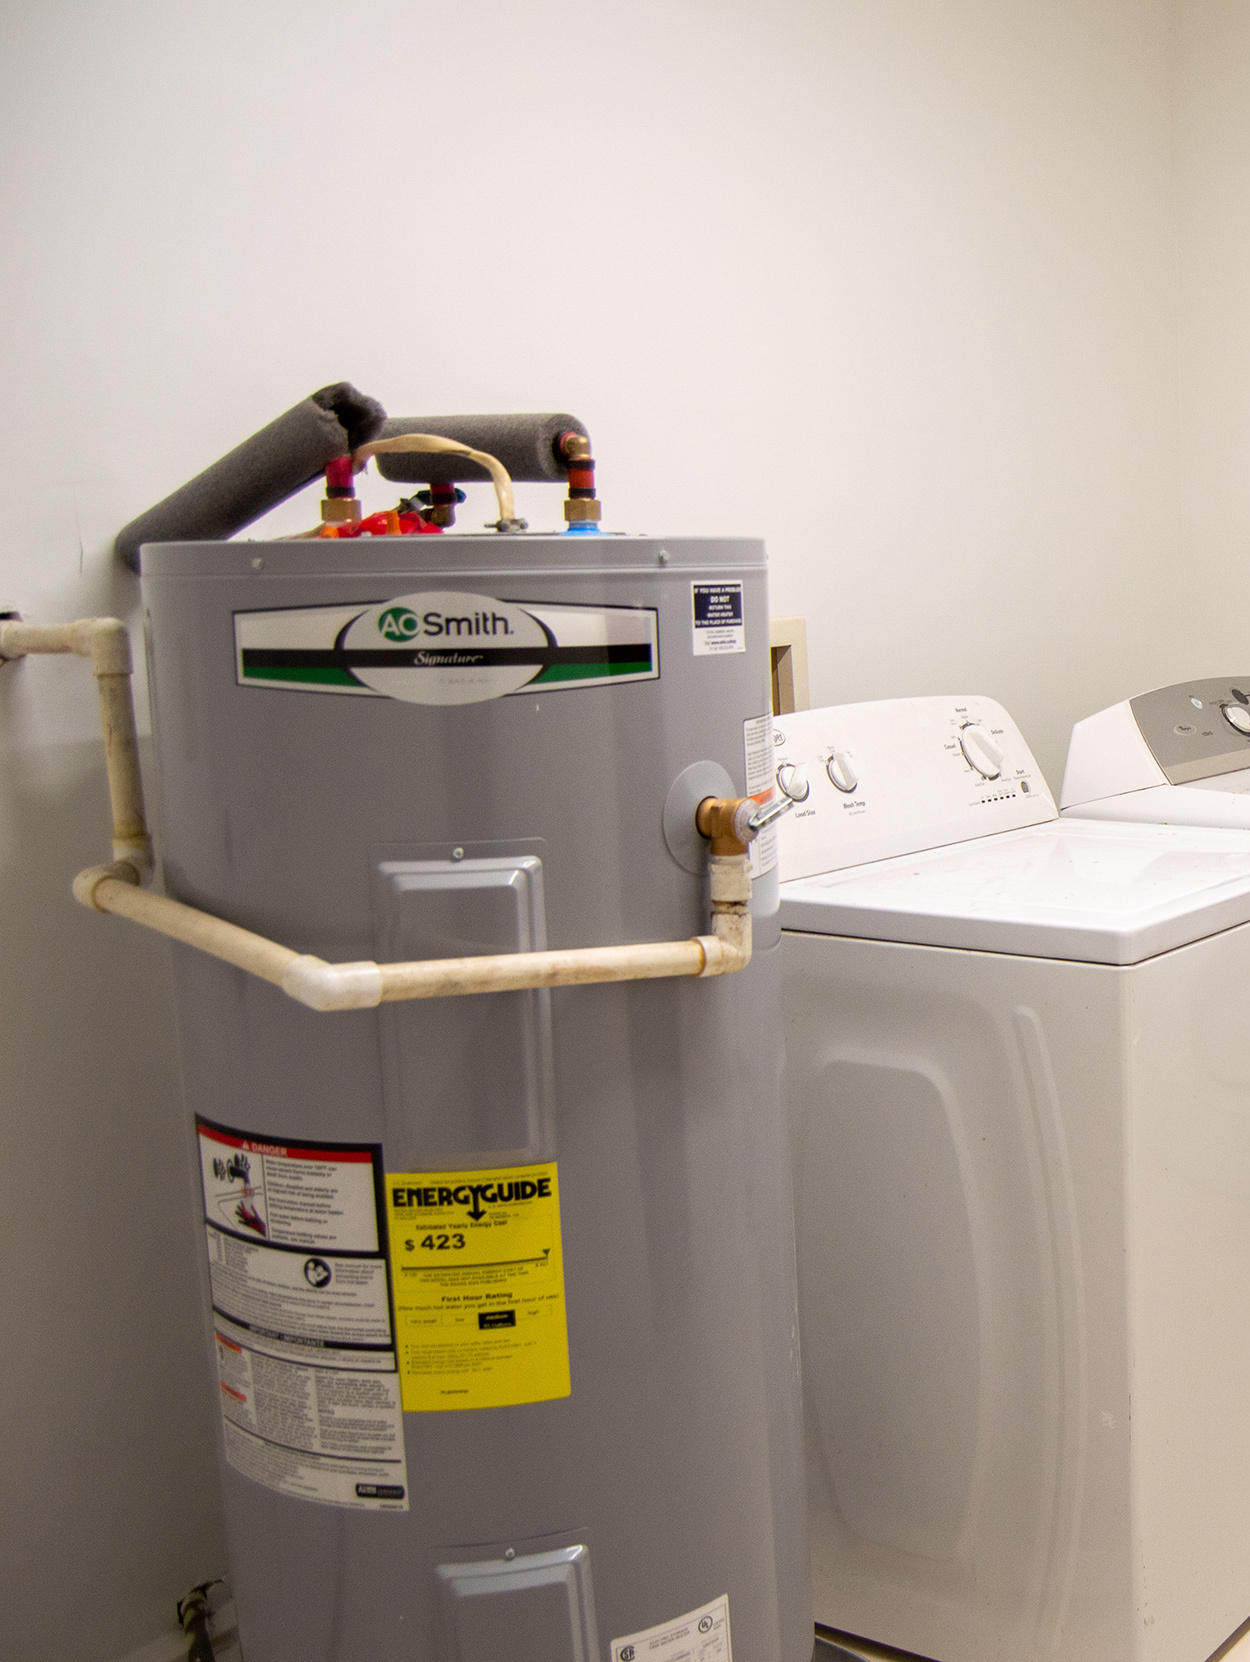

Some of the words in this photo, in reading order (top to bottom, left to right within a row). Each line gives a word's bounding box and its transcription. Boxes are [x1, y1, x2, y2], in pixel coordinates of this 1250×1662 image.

[719, 595, 730, 603] NOT
[414, 650, 483, 667] Signature
[252, 1141, 289, 1157] DANGER
[392, 1178, 552, 1208] ENERGYGUIDE
[416, 1223, 446, 1231] Estimated
[404, 1239, 415, 1251] $
[420, 1233, 466, 1250] 423
[485, 1292, 513, 1300] Rating
